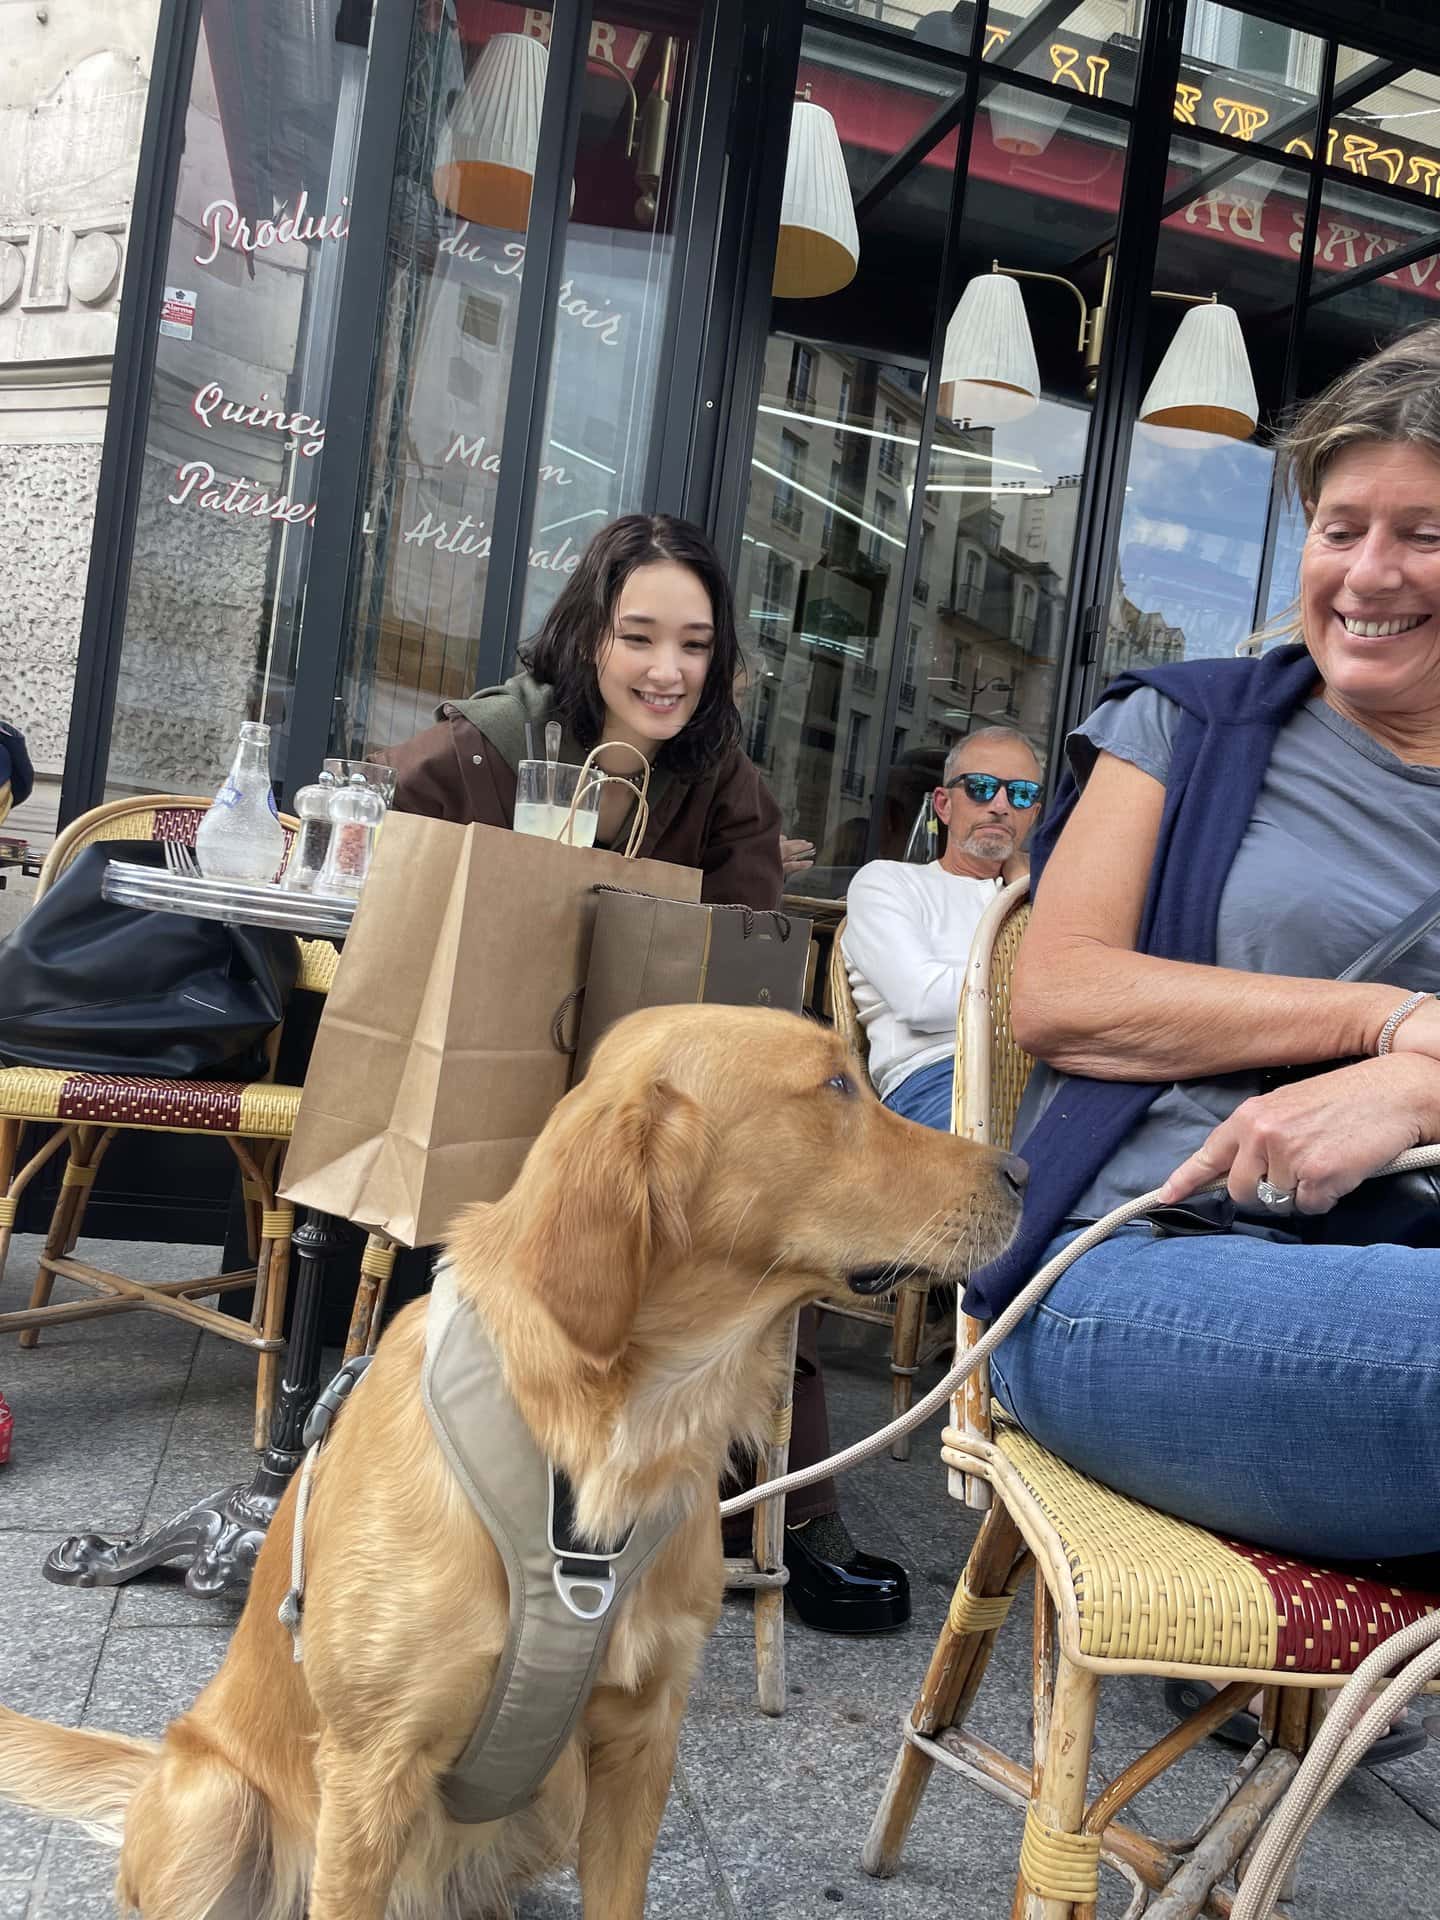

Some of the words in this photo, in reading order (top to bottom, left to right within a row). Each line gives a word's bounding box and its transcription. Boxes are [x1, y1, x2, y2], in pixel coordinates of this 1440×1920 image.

[194, 190, 352, 265] Produi
[438, 221, 487, 262] du
[192, 381, 326, 457] Quincy
[168, 461, 317, 528] Patisse
[404, 511, 580, 574] Artisale
